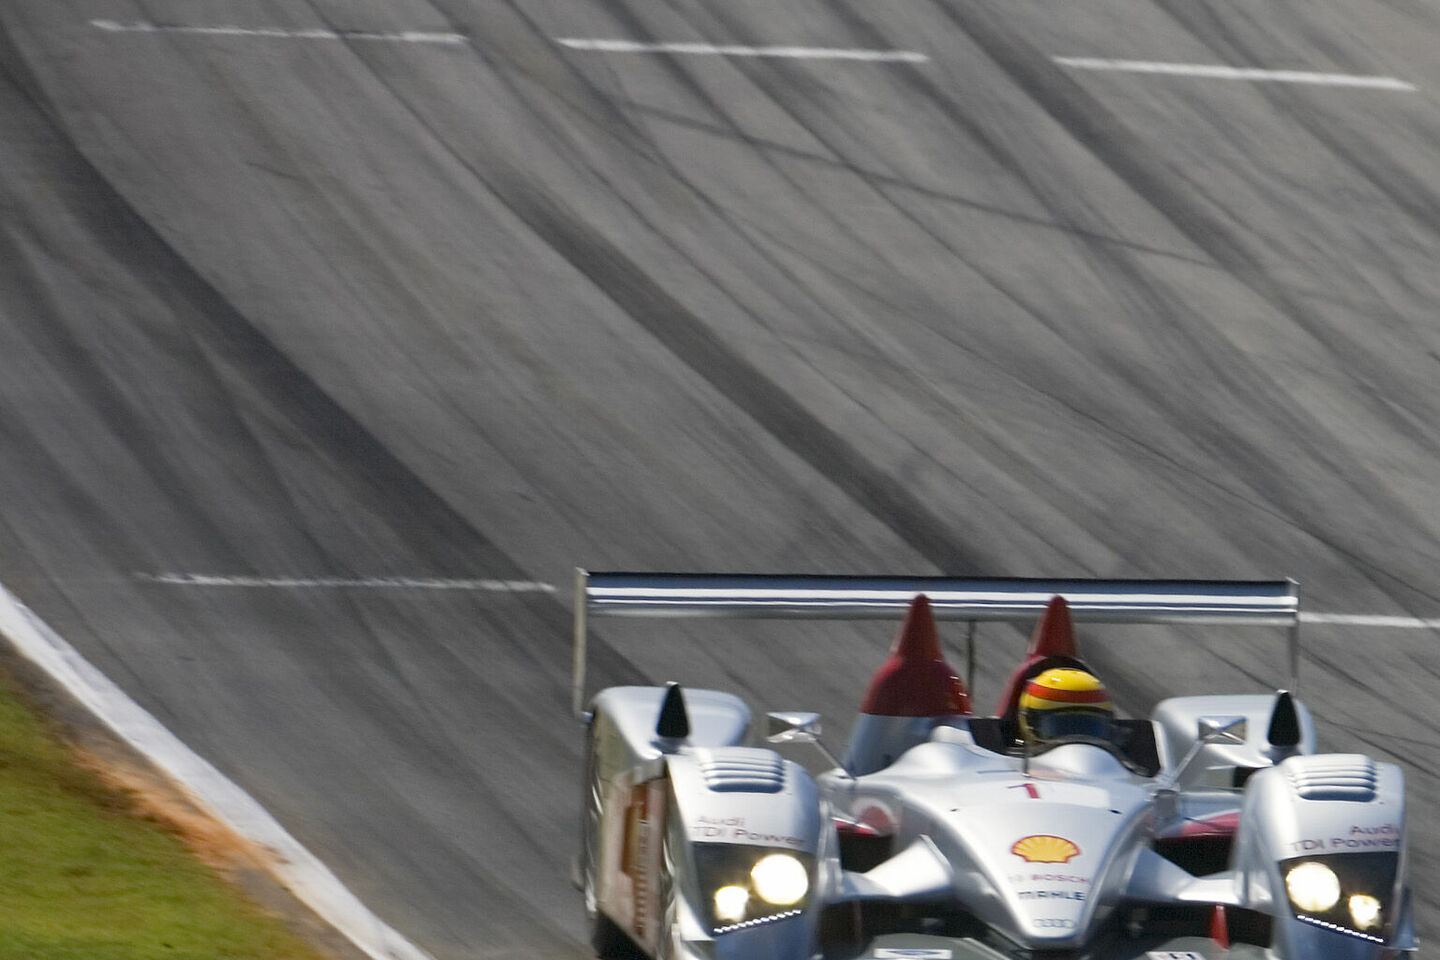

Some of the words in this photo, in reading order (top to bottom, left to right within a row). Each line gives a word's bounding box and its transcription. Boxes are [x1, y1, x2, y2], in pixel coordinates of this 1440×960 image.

[1006, 783, 1042, 799] 1
[1350, 823, 1400, 836] Audi
[735, 828, 806, 846] Power
[1331, 838, 1401, 849] Power
